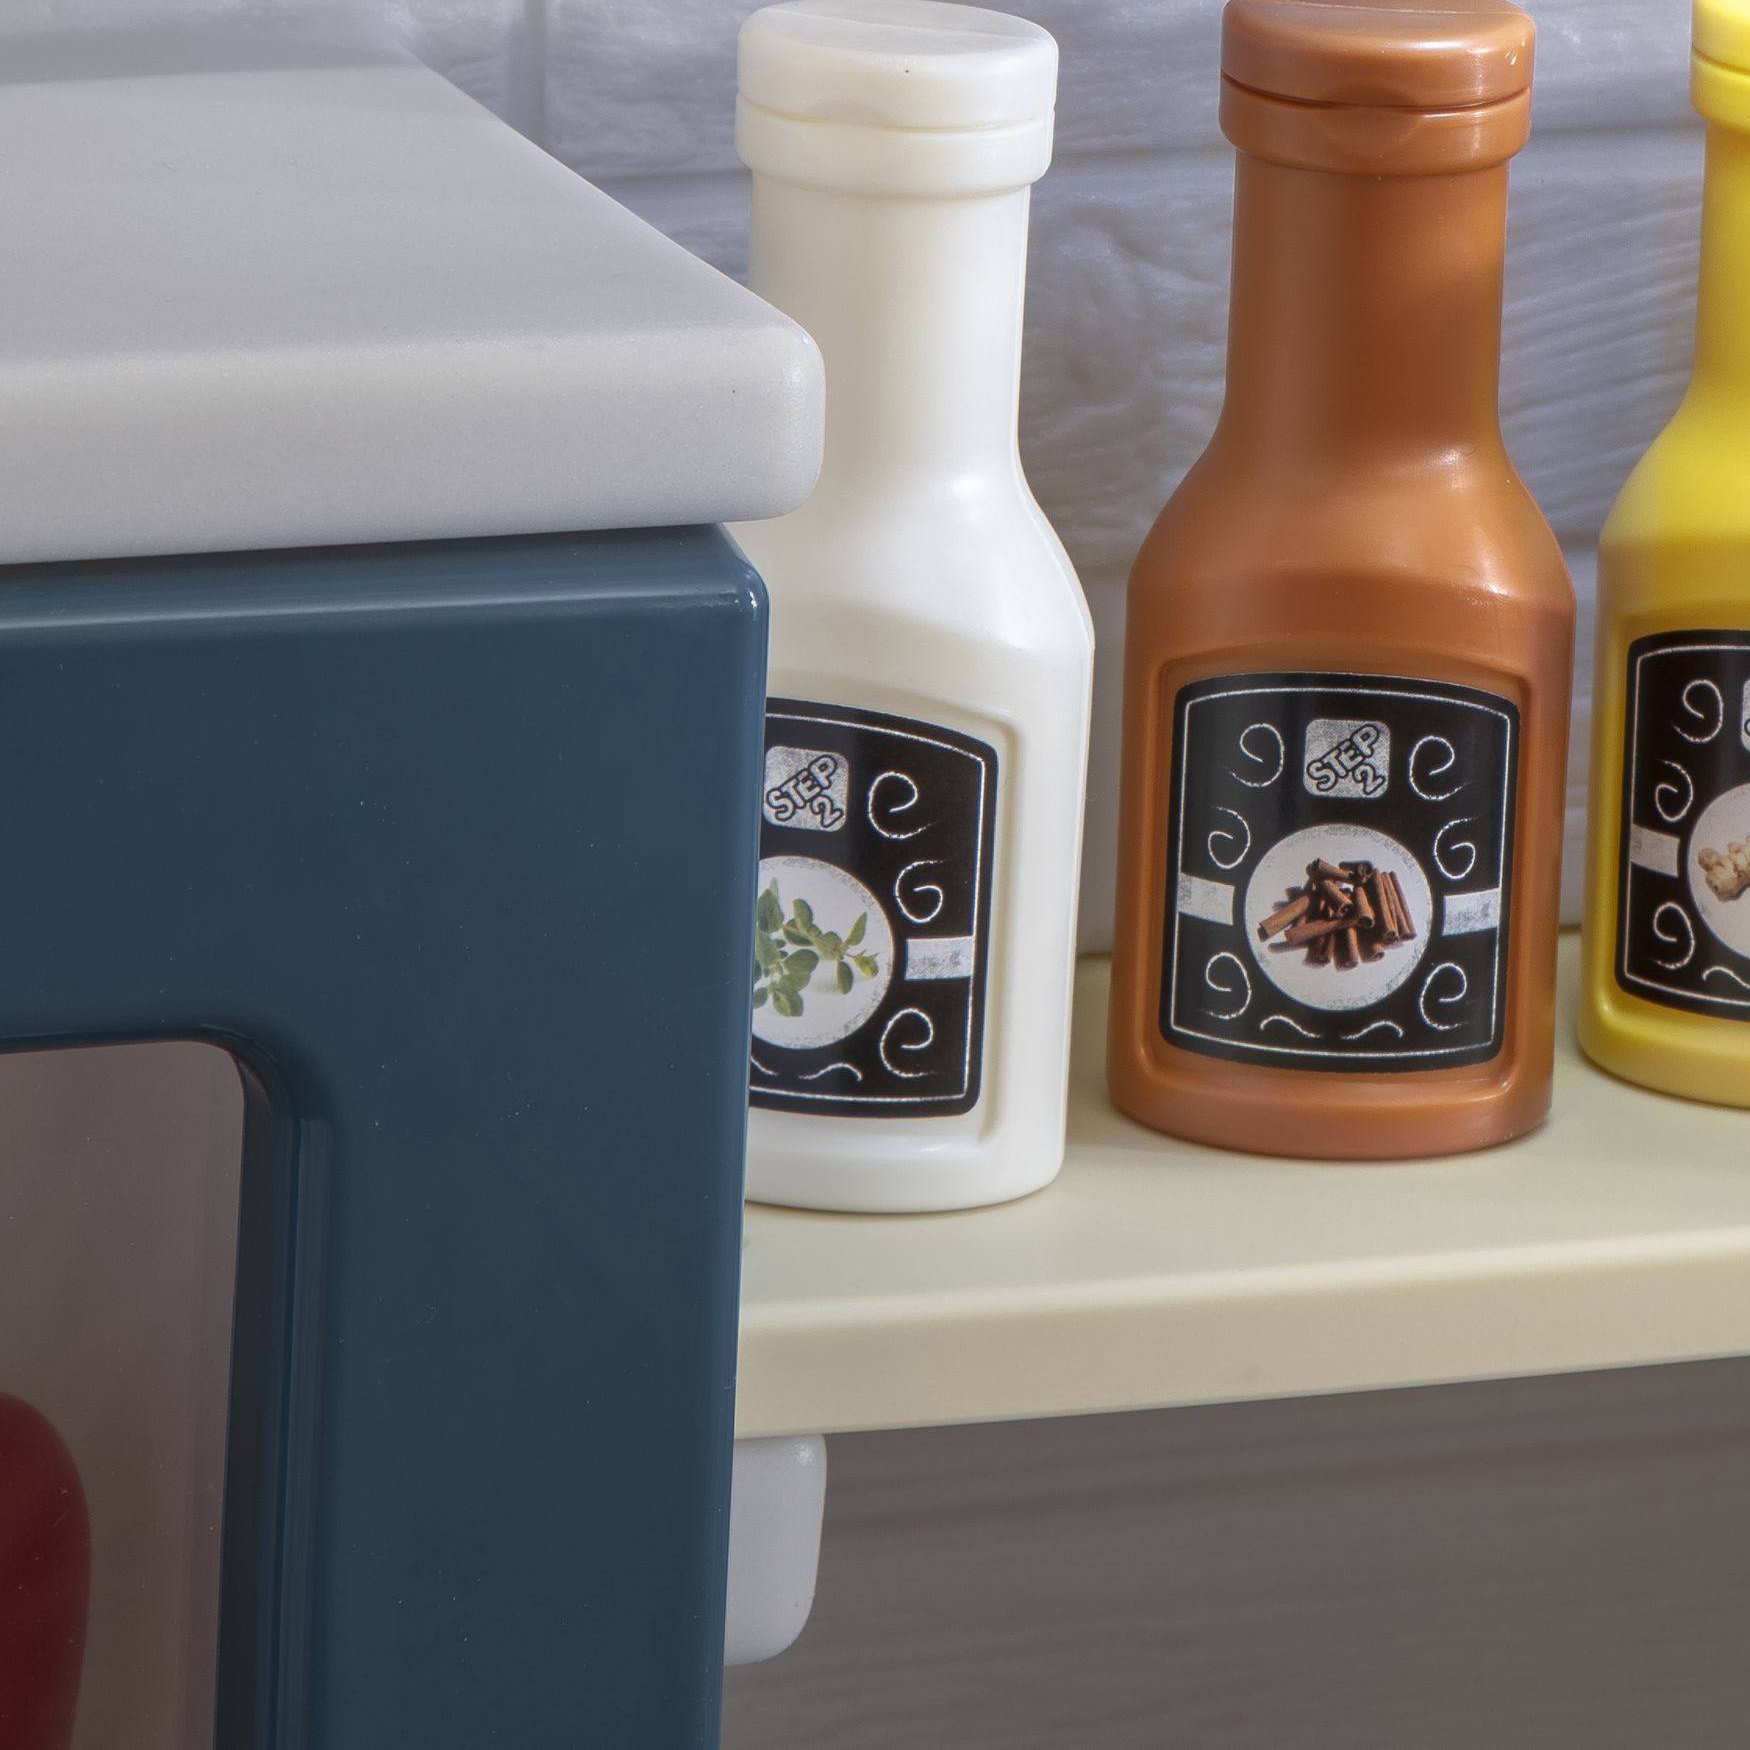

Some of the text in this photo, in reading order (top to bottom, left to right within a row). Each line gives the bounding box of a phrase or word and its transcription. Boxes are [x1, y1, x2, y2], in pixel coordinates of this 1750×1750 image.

[1307, 723, 1380, 791] STEP
[1352, 762, 1386, 796] 2
[766, 753, 837, 822] STEP
[809, 792, 844, 828] 2
